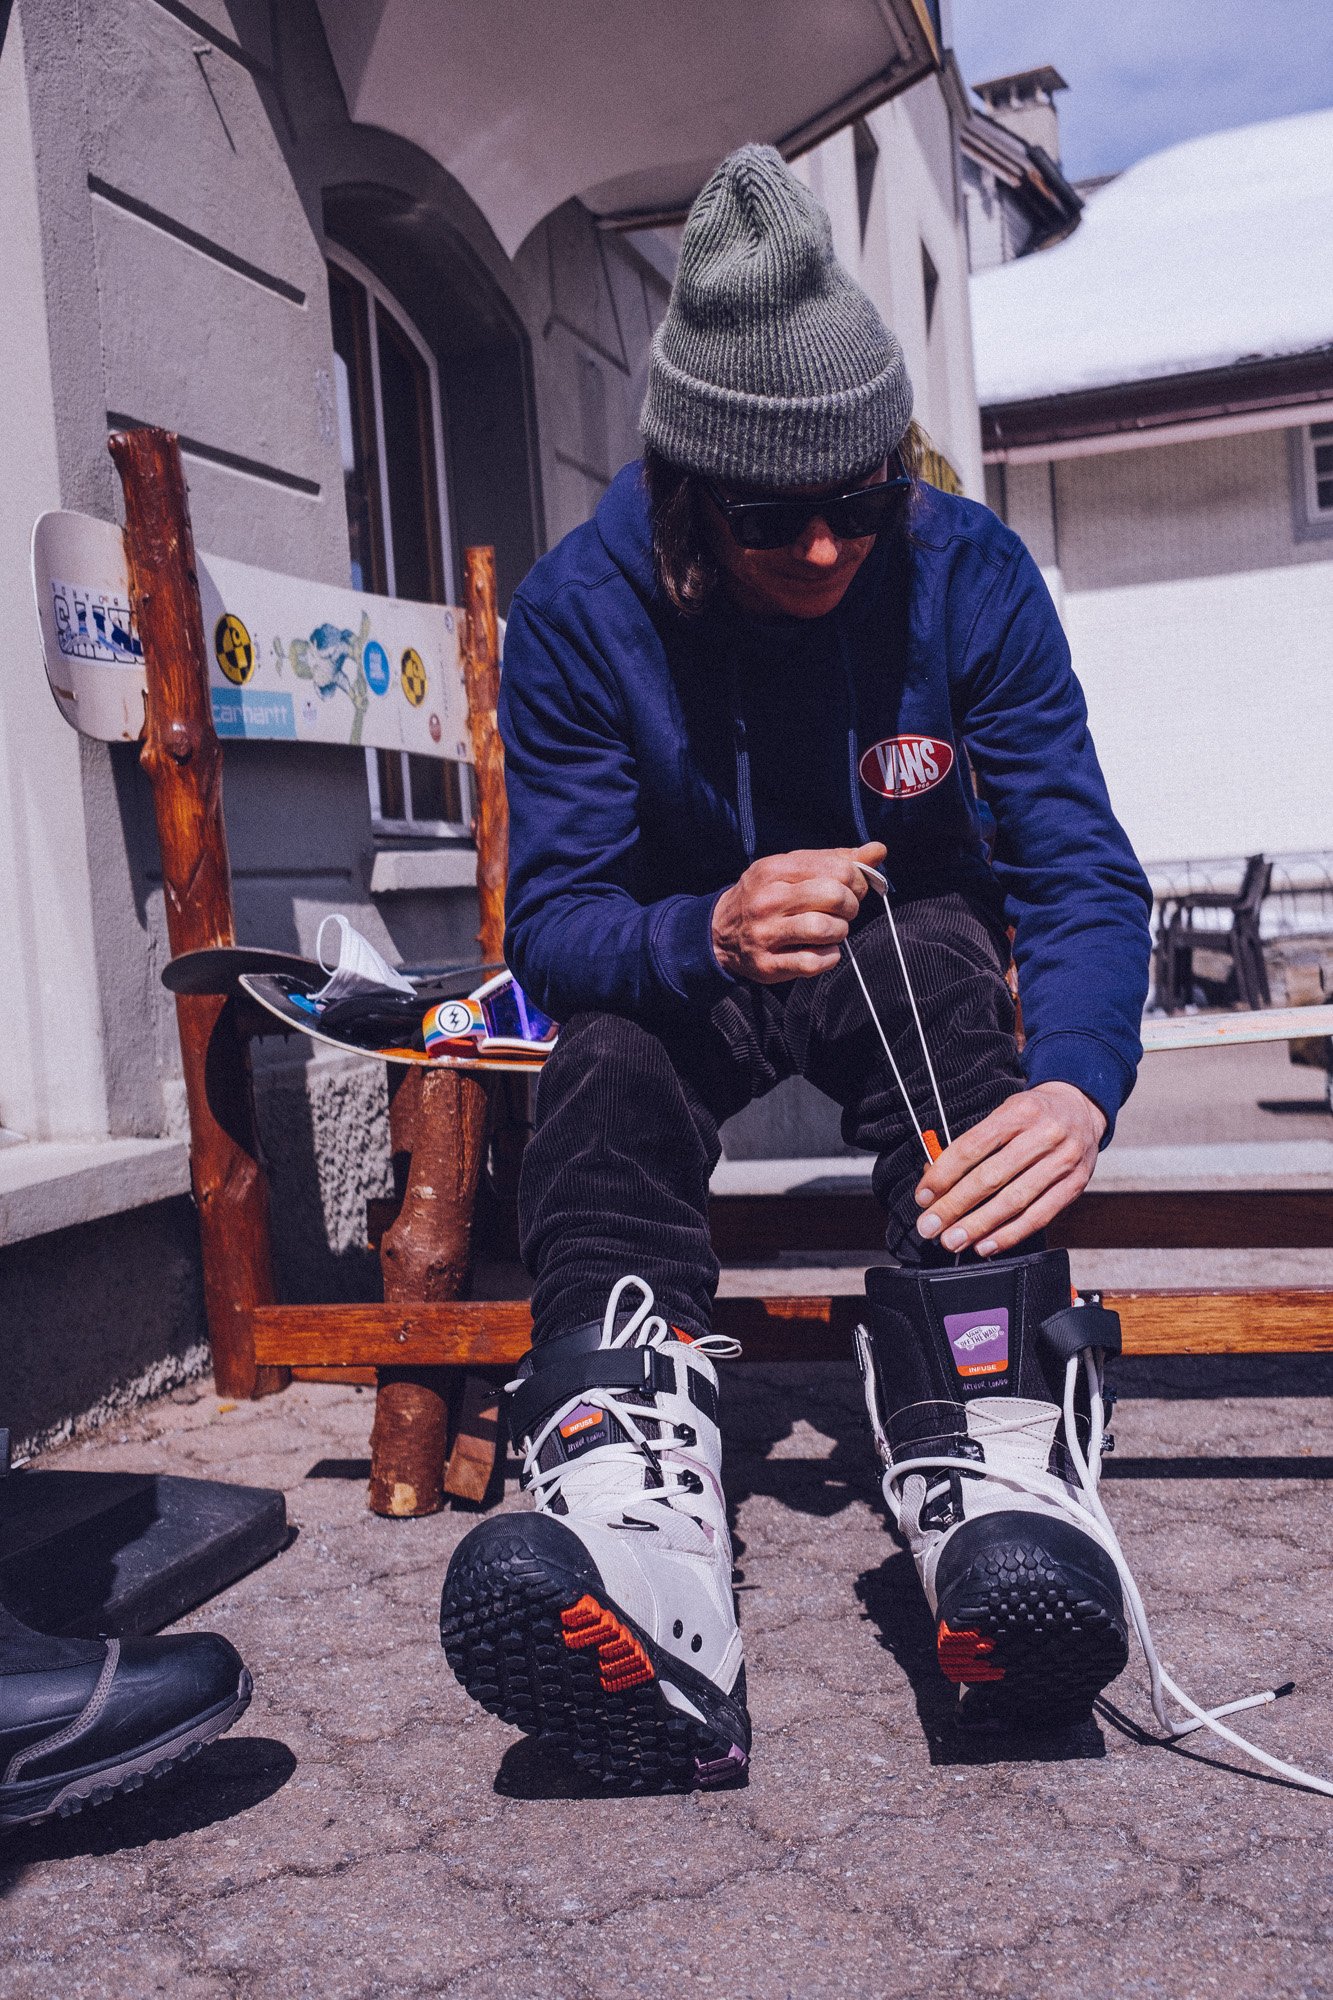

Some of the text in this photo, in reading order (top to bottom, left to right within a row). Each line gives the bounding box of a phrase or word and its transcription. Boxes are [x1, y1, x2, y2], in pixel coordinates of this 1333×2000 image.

[875, 740, 939, 790] VANS
[971, 1336, 984, 1344] THE
[969, 1364, 997, 1373] INFUSE
[570, 1418, 593, 1432] INFUSE
